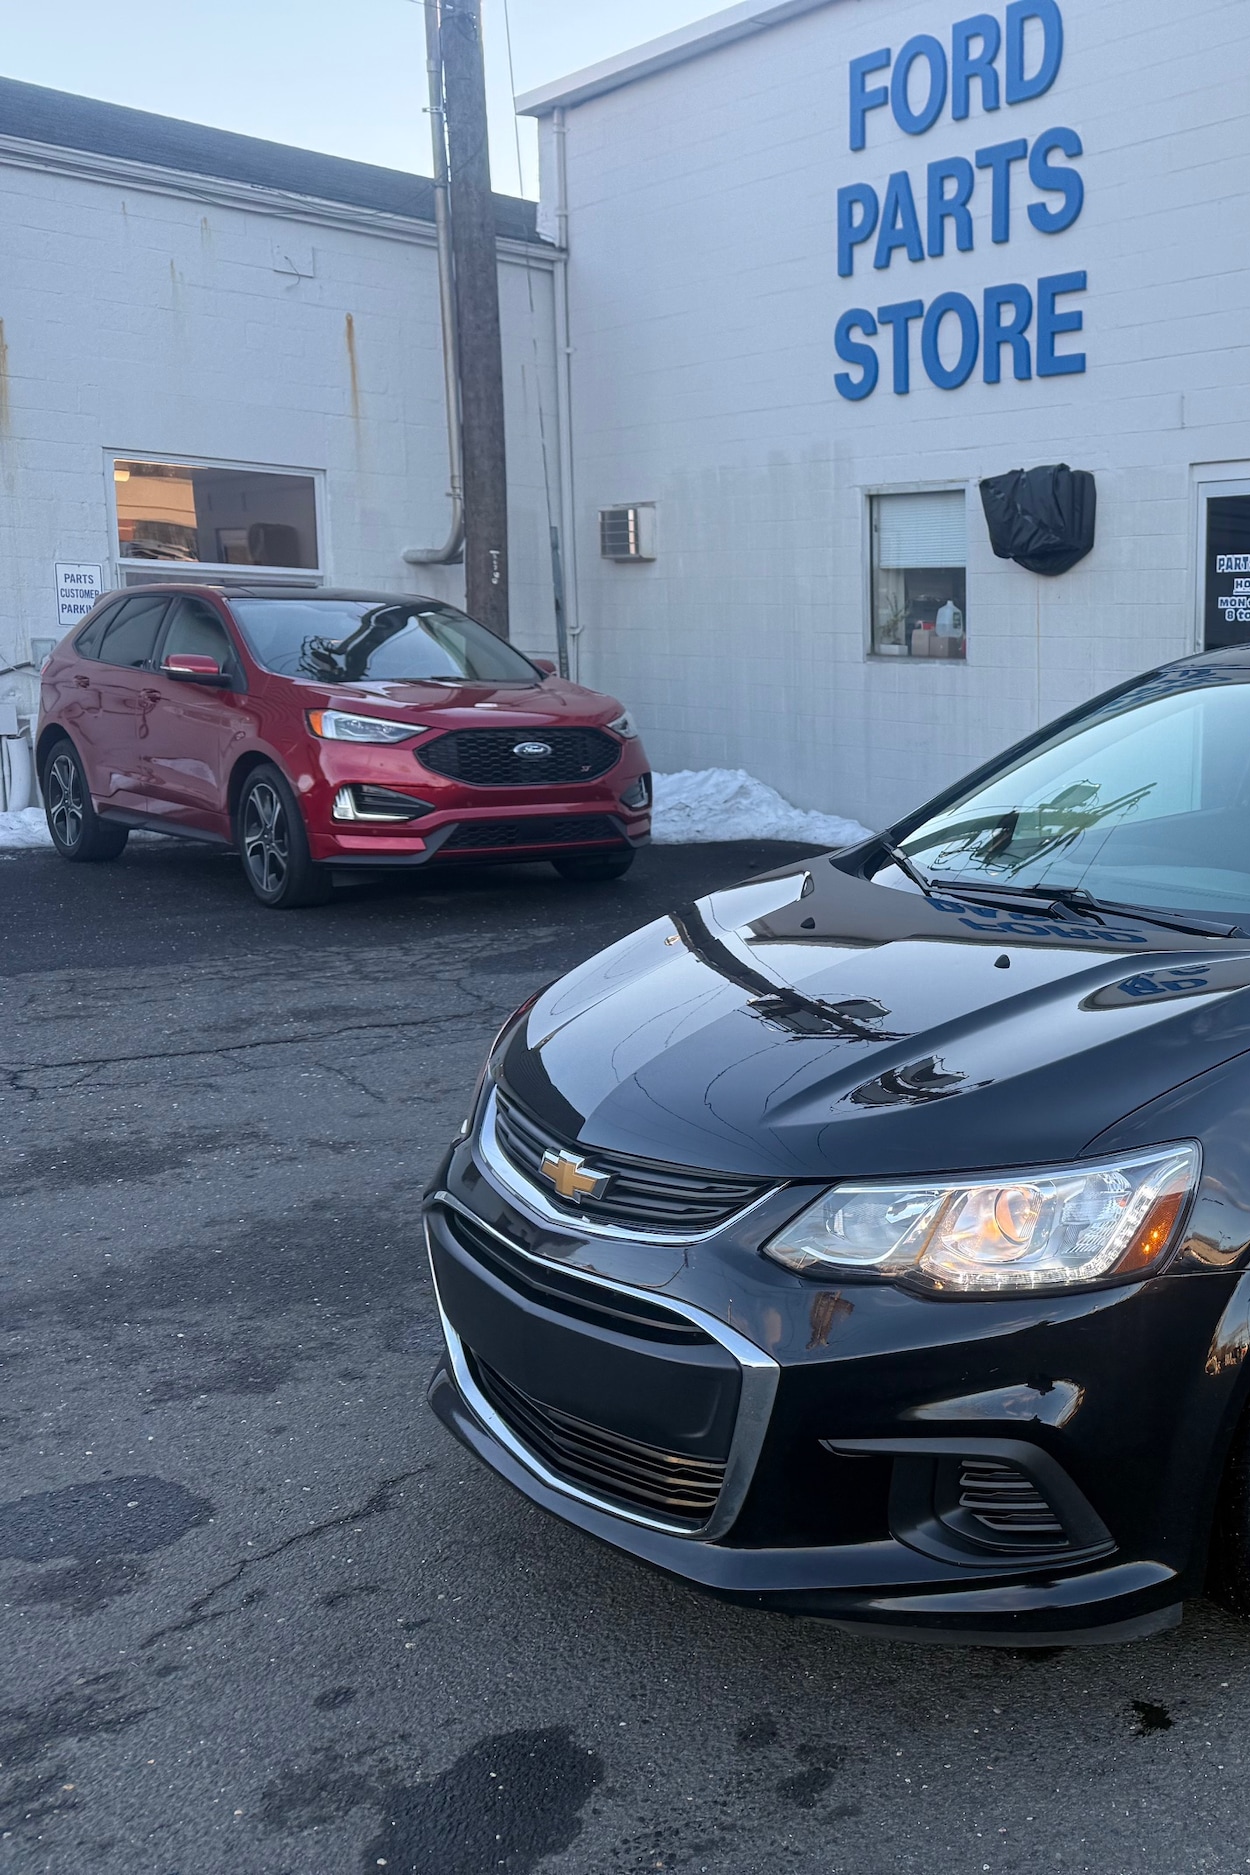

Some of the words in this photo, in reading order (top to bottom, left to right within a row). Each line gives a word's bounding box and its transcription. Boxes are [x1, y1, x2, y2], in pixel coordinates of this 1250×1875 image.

[849, 0, 1064, 151] FORD
[836, 126, 1084, 278] PARTS
[833, 270, 1087, 401] STORE
[64, 573, 94, 584] PARTS
[1218, 597, 1246, 608] MON
[1225, 609, 1235, 621] 8
